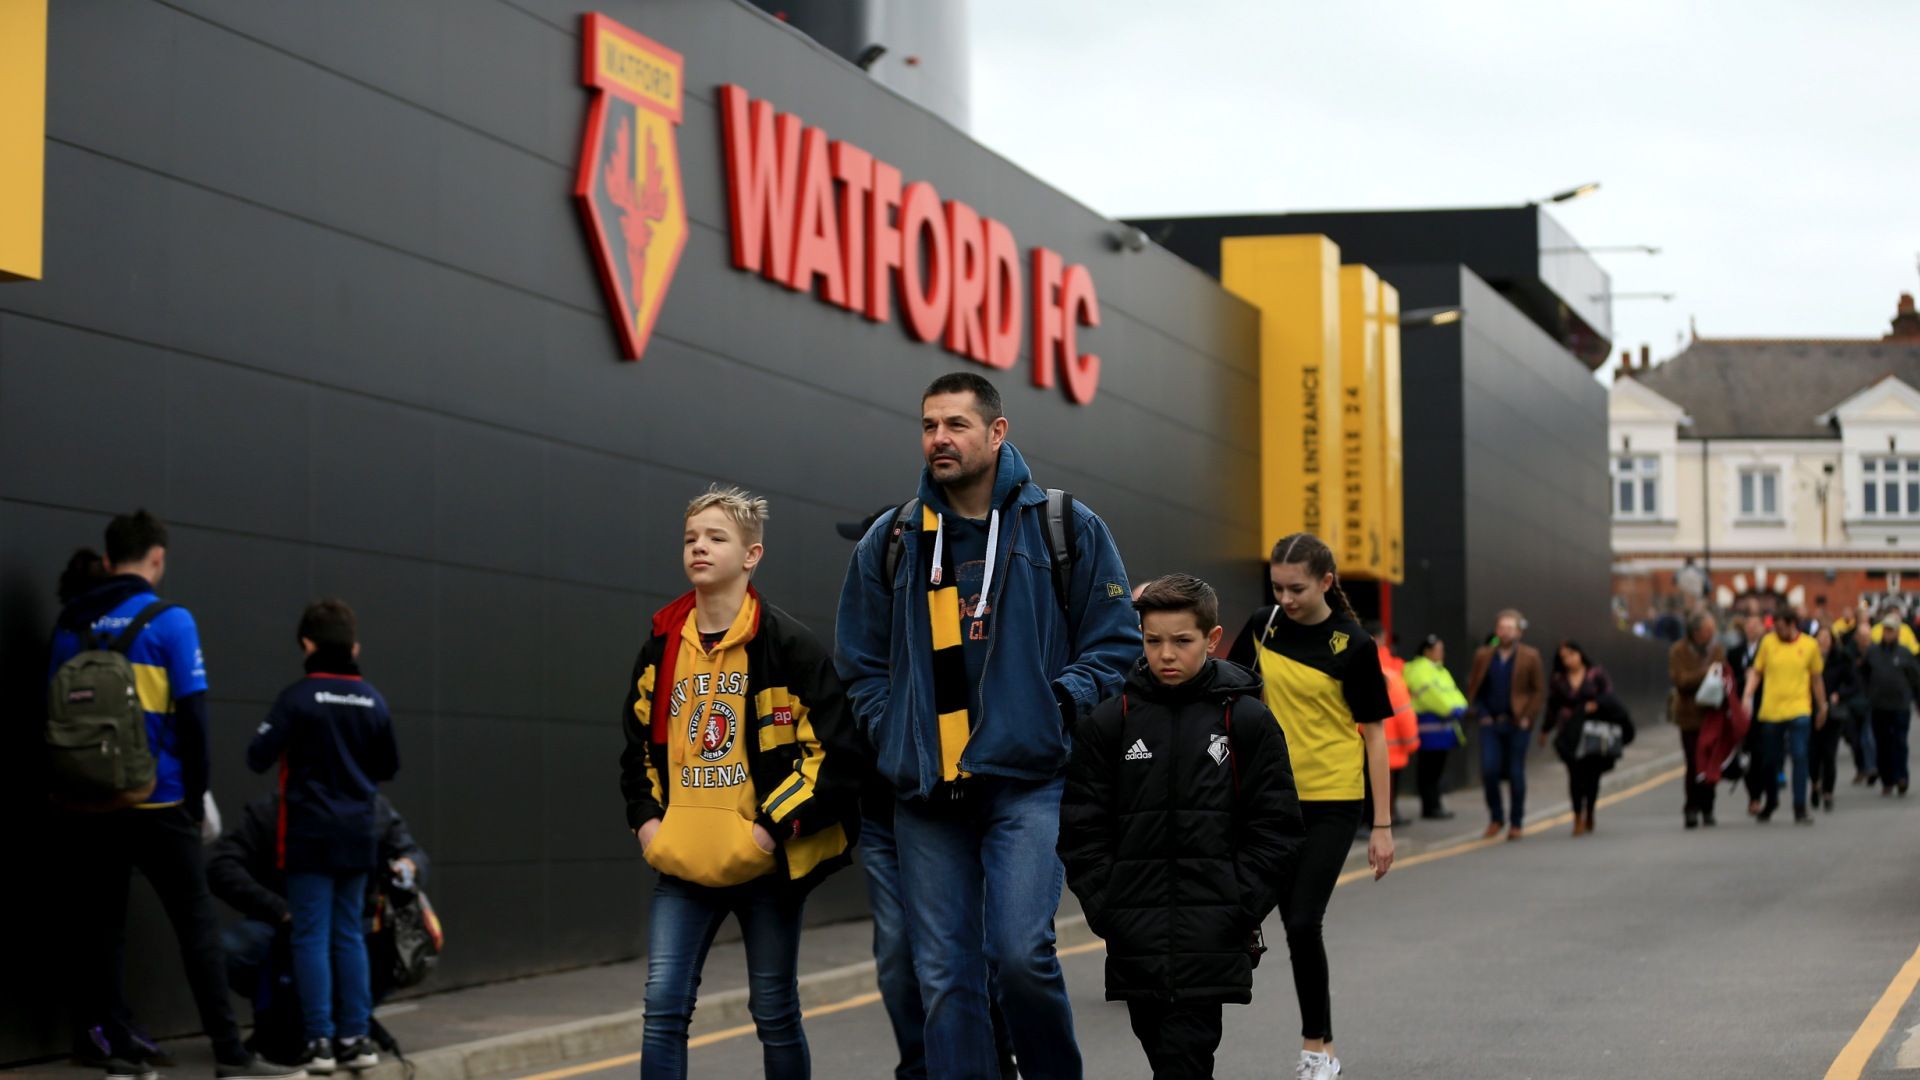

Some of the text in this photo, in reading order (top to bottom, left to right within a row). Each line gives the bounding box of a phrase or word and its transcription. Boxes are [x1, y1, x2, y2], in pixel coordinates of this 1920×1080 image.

[718, 83, 1100, 405] WATFORD FC
[1302, 365, 1321, 536] EDIA ENTRANCE
[1344, 431, 1361, 563] TURNSTILE
[671, 671, 749, 716] UNERSI
[774, 710, 792, 724] ap
[703, 750, 723, 759] SIENA
[1125, 751, 1152, 761] adidas
[681, 763, 748, 788] SIENA
